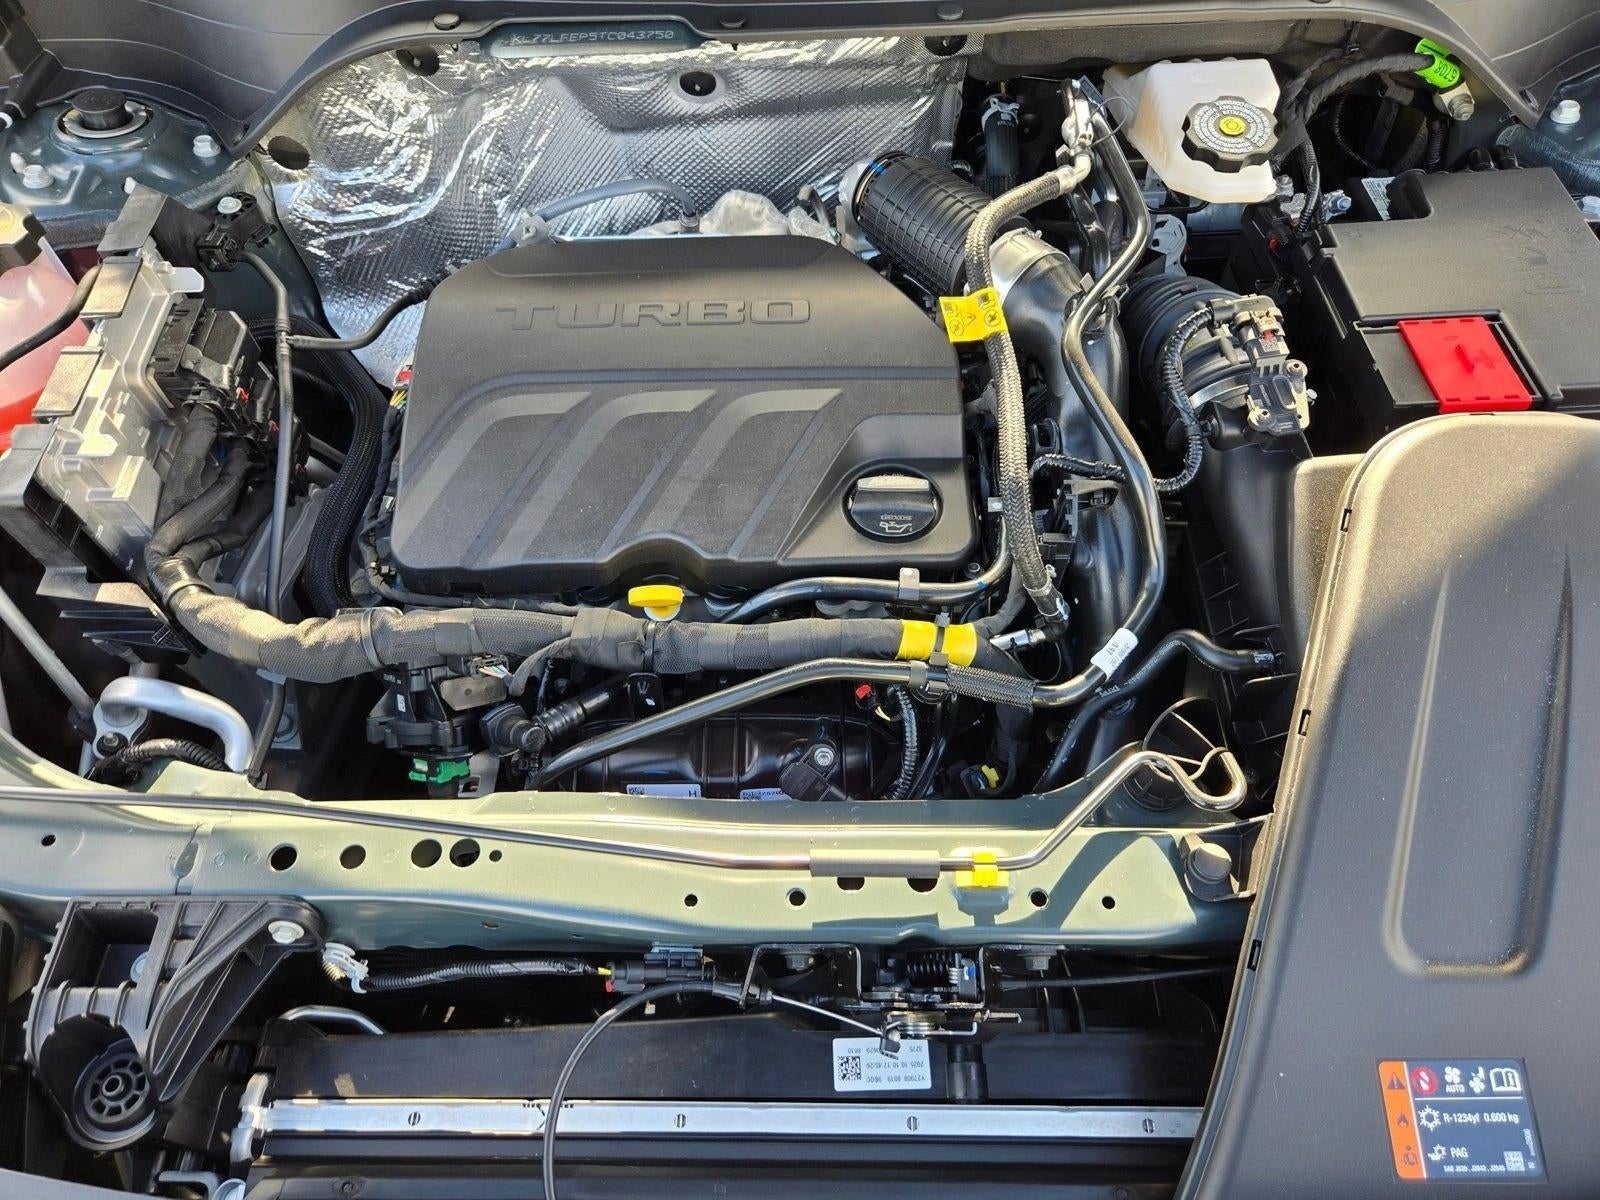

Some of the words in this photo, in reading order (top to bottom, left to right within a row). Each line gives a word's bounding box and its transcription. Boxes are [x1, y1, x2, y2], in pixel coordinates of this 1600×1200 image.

[510, 30, 674, 45] KL77LFEP5TC043750
[495, 300, 811, 330] TURBO
[1445, 1084, 1465, 1093] AUTO
[1443, 1112, 1480, 1124] R-1234yf
[1483, 1112, 1507, 1123] 0.600
[1507, 1112, 1520, 1124] kg
[1450, 1147, 1469, 1158] PAG
